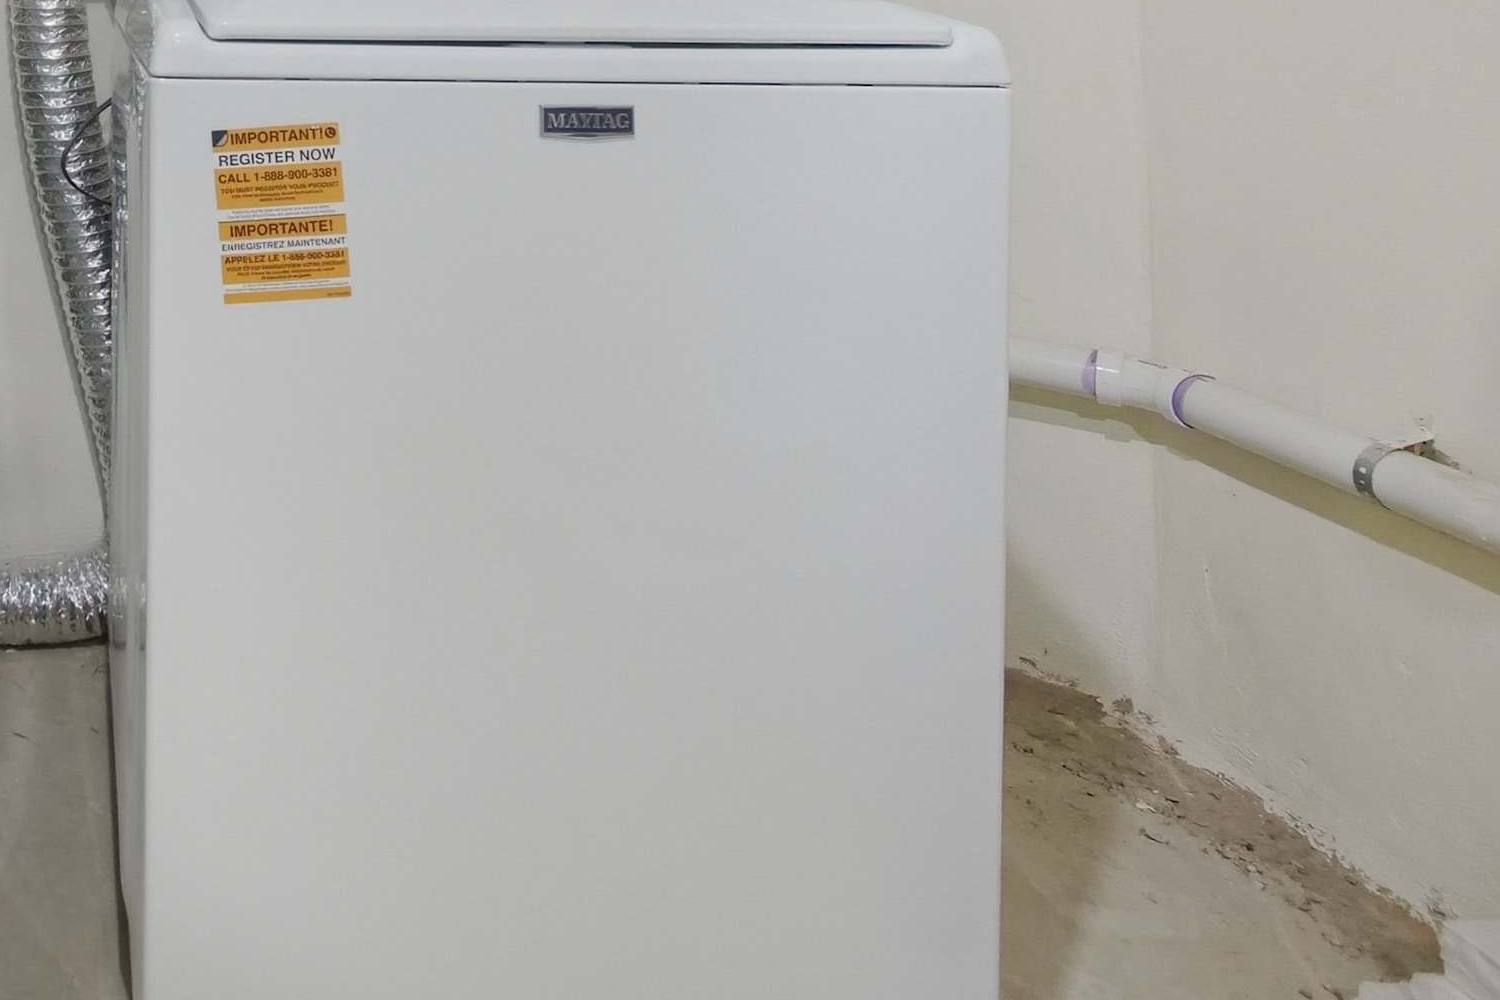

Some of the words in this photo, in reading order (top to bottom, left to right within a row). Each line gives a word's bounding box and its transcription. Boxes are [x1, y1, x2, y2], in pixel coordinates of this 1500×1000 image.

[547, 112, 630, 129] MAYTAG
[230, 127, 323, 145] IMPORTANT!
[218, 151, 295, 167] REGISTER
[300, 147, 336, 162] NOW
[218, 172, 250, 185] CALL
[230, 219, 333, 238] IMPORTANTE!
